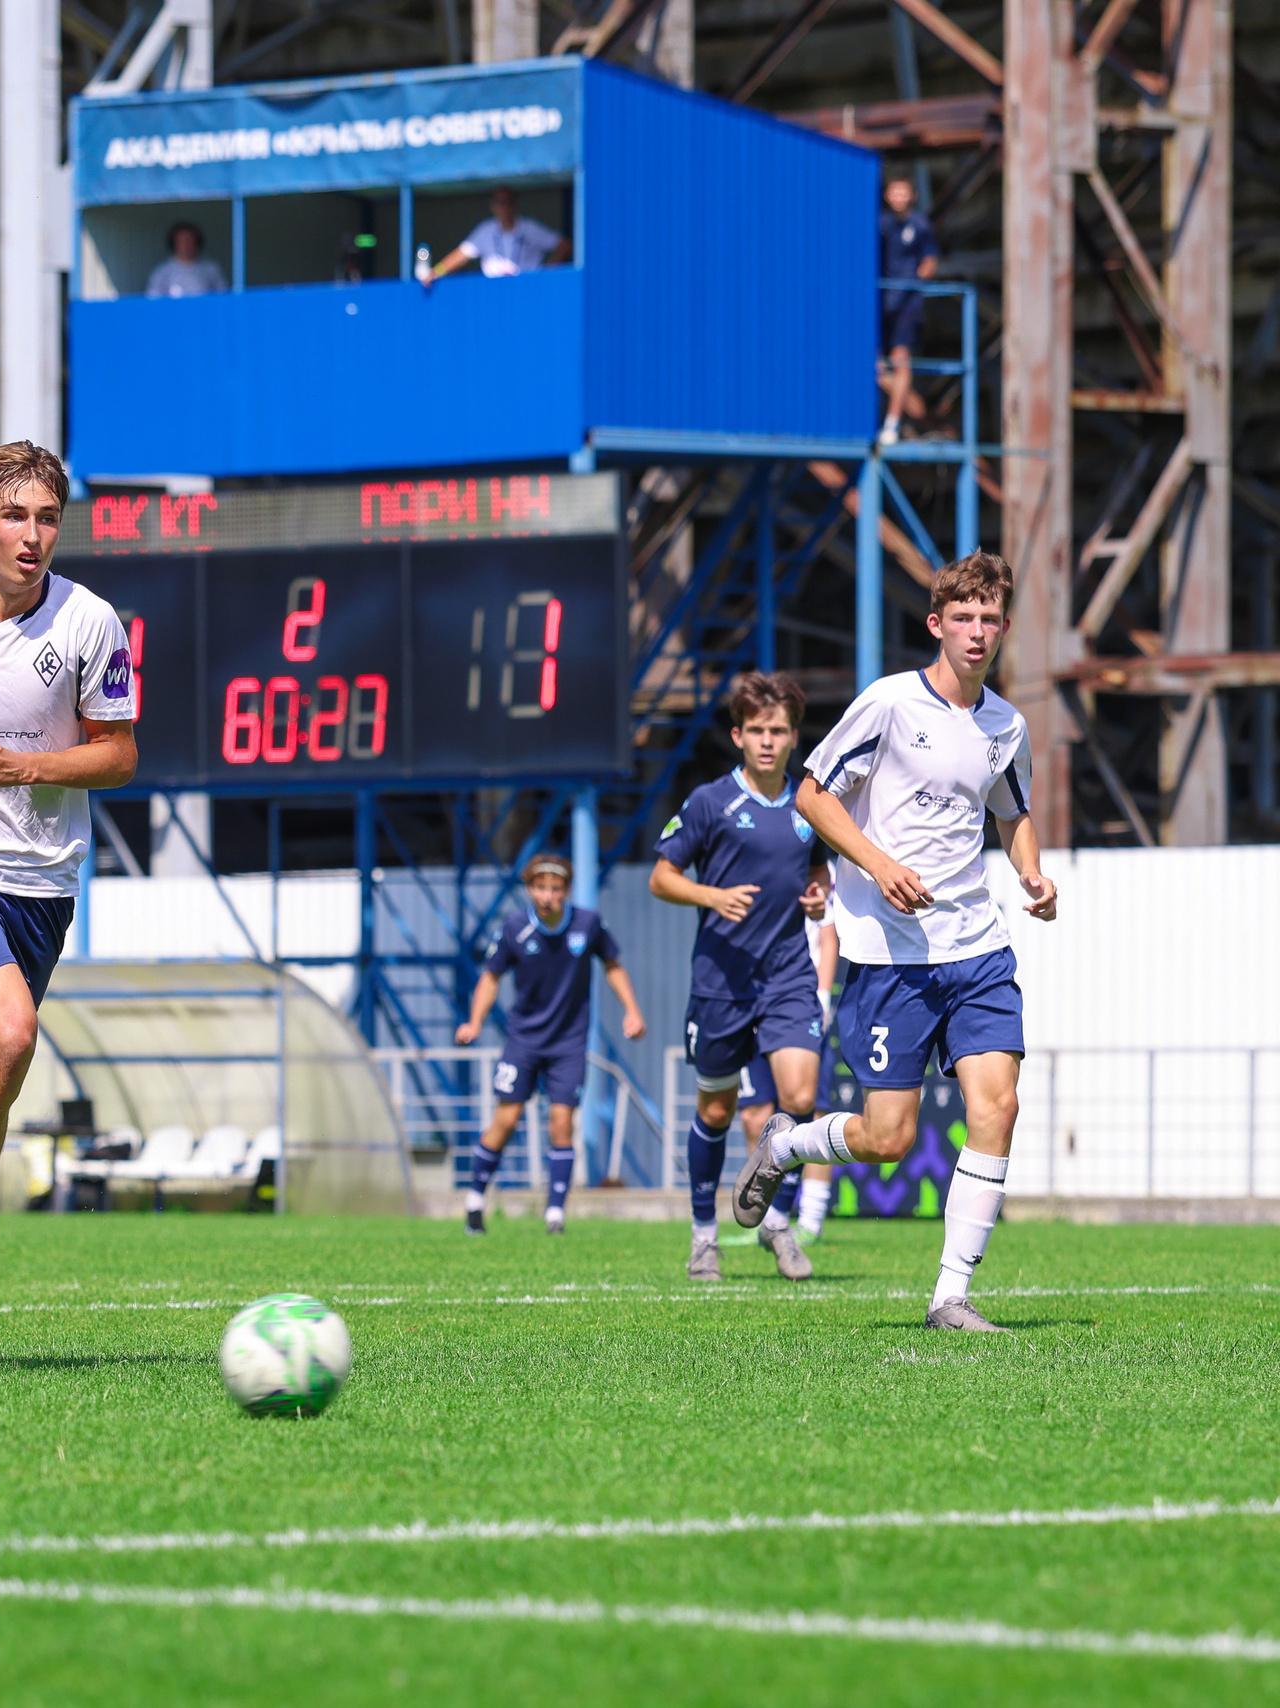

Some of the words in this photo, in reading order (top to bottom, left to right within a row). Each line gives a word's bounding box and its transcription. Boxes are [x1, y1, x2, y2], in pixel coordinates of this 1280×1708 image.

[104, 127, 270, 170] АКАДЕМИЯ
[361, 478, 478, 543] ПАРИ
[490, 474, 550, 538] НН
[283, 579, 326, 662] 2
[540, 599, 562, 711] 1
[222, 675, 389, 764] 60:27
[868, 1026, 890, 1073] 3
